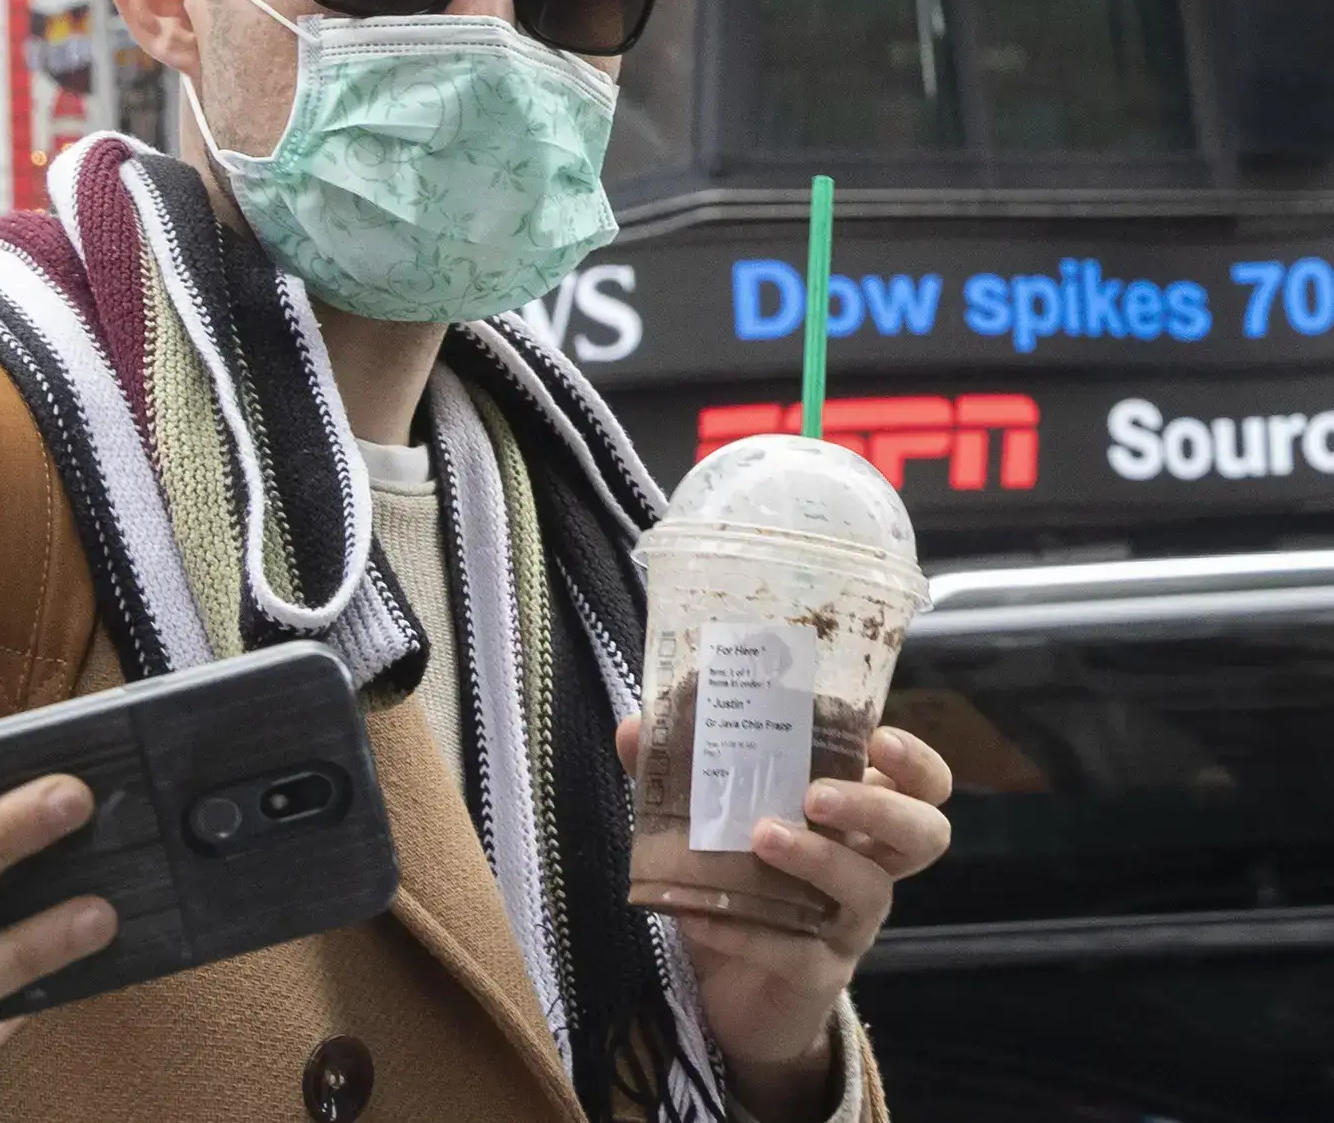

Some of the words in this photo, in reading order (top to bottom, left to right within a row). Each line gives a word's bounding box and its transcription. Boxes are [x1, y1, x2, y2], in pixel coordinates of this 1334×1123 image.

[731, 259, 942, 343] Dow
[964, 256, 1210, 353] spikes
[718, 718, 740, 730] Java
[741, 719, 764, 732] Chip
